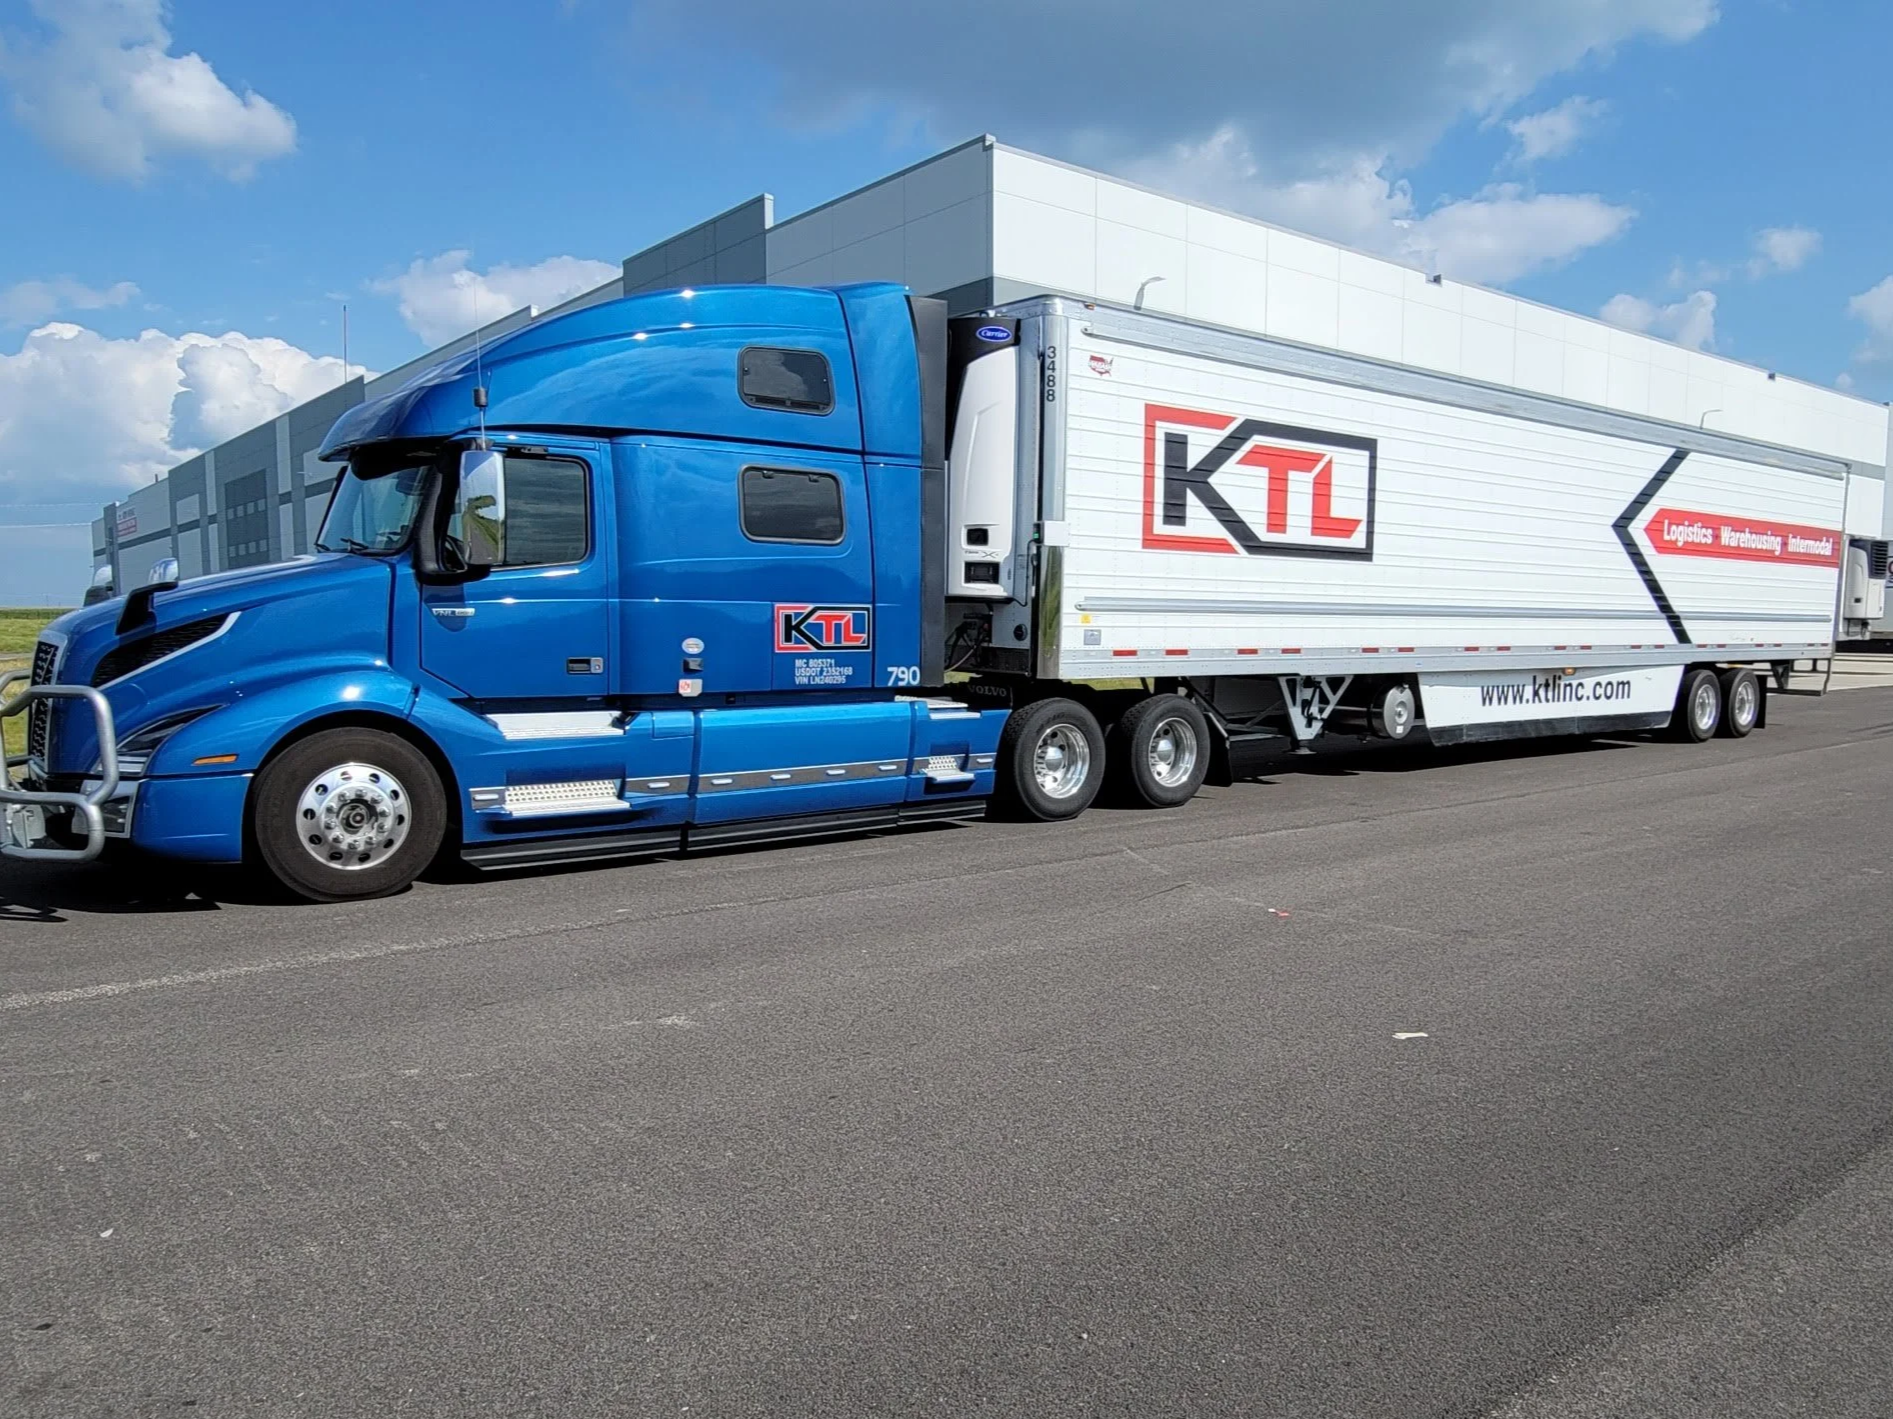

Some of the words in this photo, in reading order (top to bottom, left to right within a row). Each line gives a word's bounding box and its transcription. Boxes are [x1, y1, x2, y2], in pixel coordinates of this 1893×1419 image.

[981, 329, 1008, 338] Carrier
[1046, 346, 1056, 402] 3488
[1163, 418, 1364, 556] KTL
[1663, 519, 1713, 547] Logistics
[1720, 526, 1782, 555] Warehousing
[1788, 534, 1832, 555] Intermodal
[783, 606, 866, 650] KTL
[795, 659, 807, 667] MC
[795, 667, 820, 676] USDOT
[794, 676, 808, 684] VIN
[887, 666, 920, 686] 790
[967, 685, 1007, 697] VOLVO
[1481, 675, 1631, 706] www.ktlinc.com
